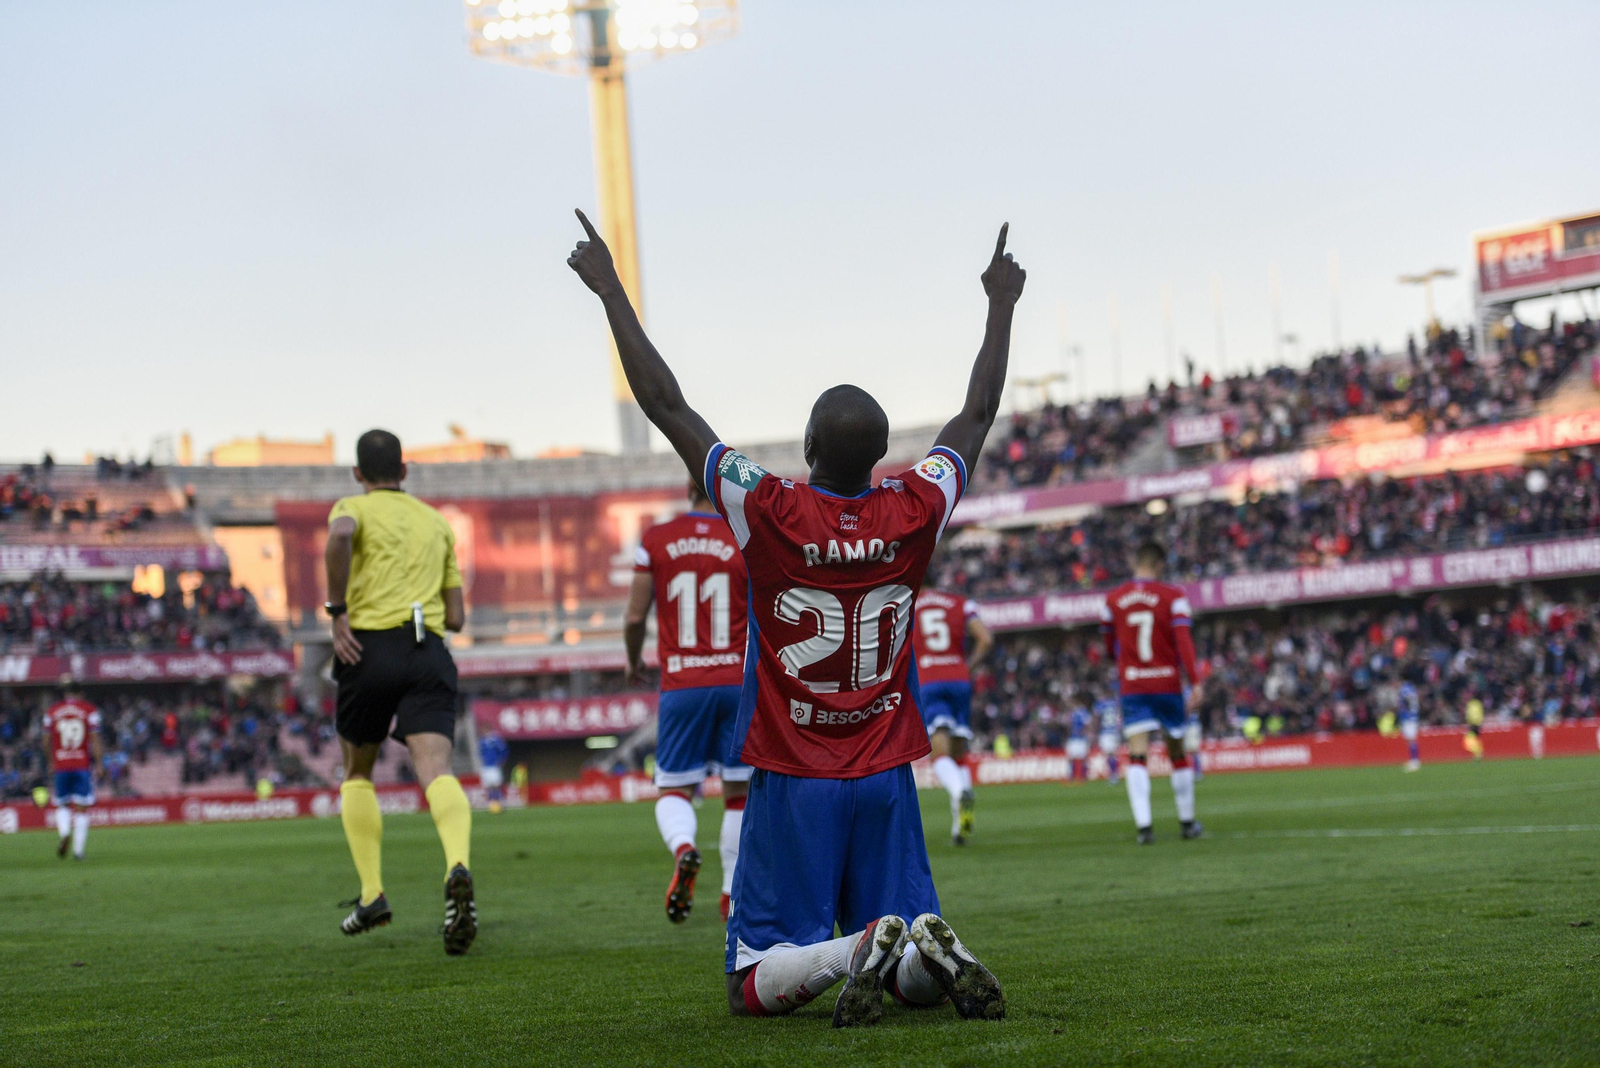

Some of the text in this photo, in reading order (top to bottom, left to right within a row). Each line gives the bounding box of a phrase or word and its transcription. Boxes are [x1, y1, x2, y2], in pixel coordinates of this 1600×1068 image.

[665, 537, 735, 561] RODRIGO
[802, 538, 901, 567] RAMOS
[667, 571, 730, 649] 11
[773, 584, 913, 693] 20
[920, 609, 951, 652] 5
[1126, 610, 1154, 663] 7
[816, 692, 902, 724] BESOCCER
[56, 718, 86, 750] 19
